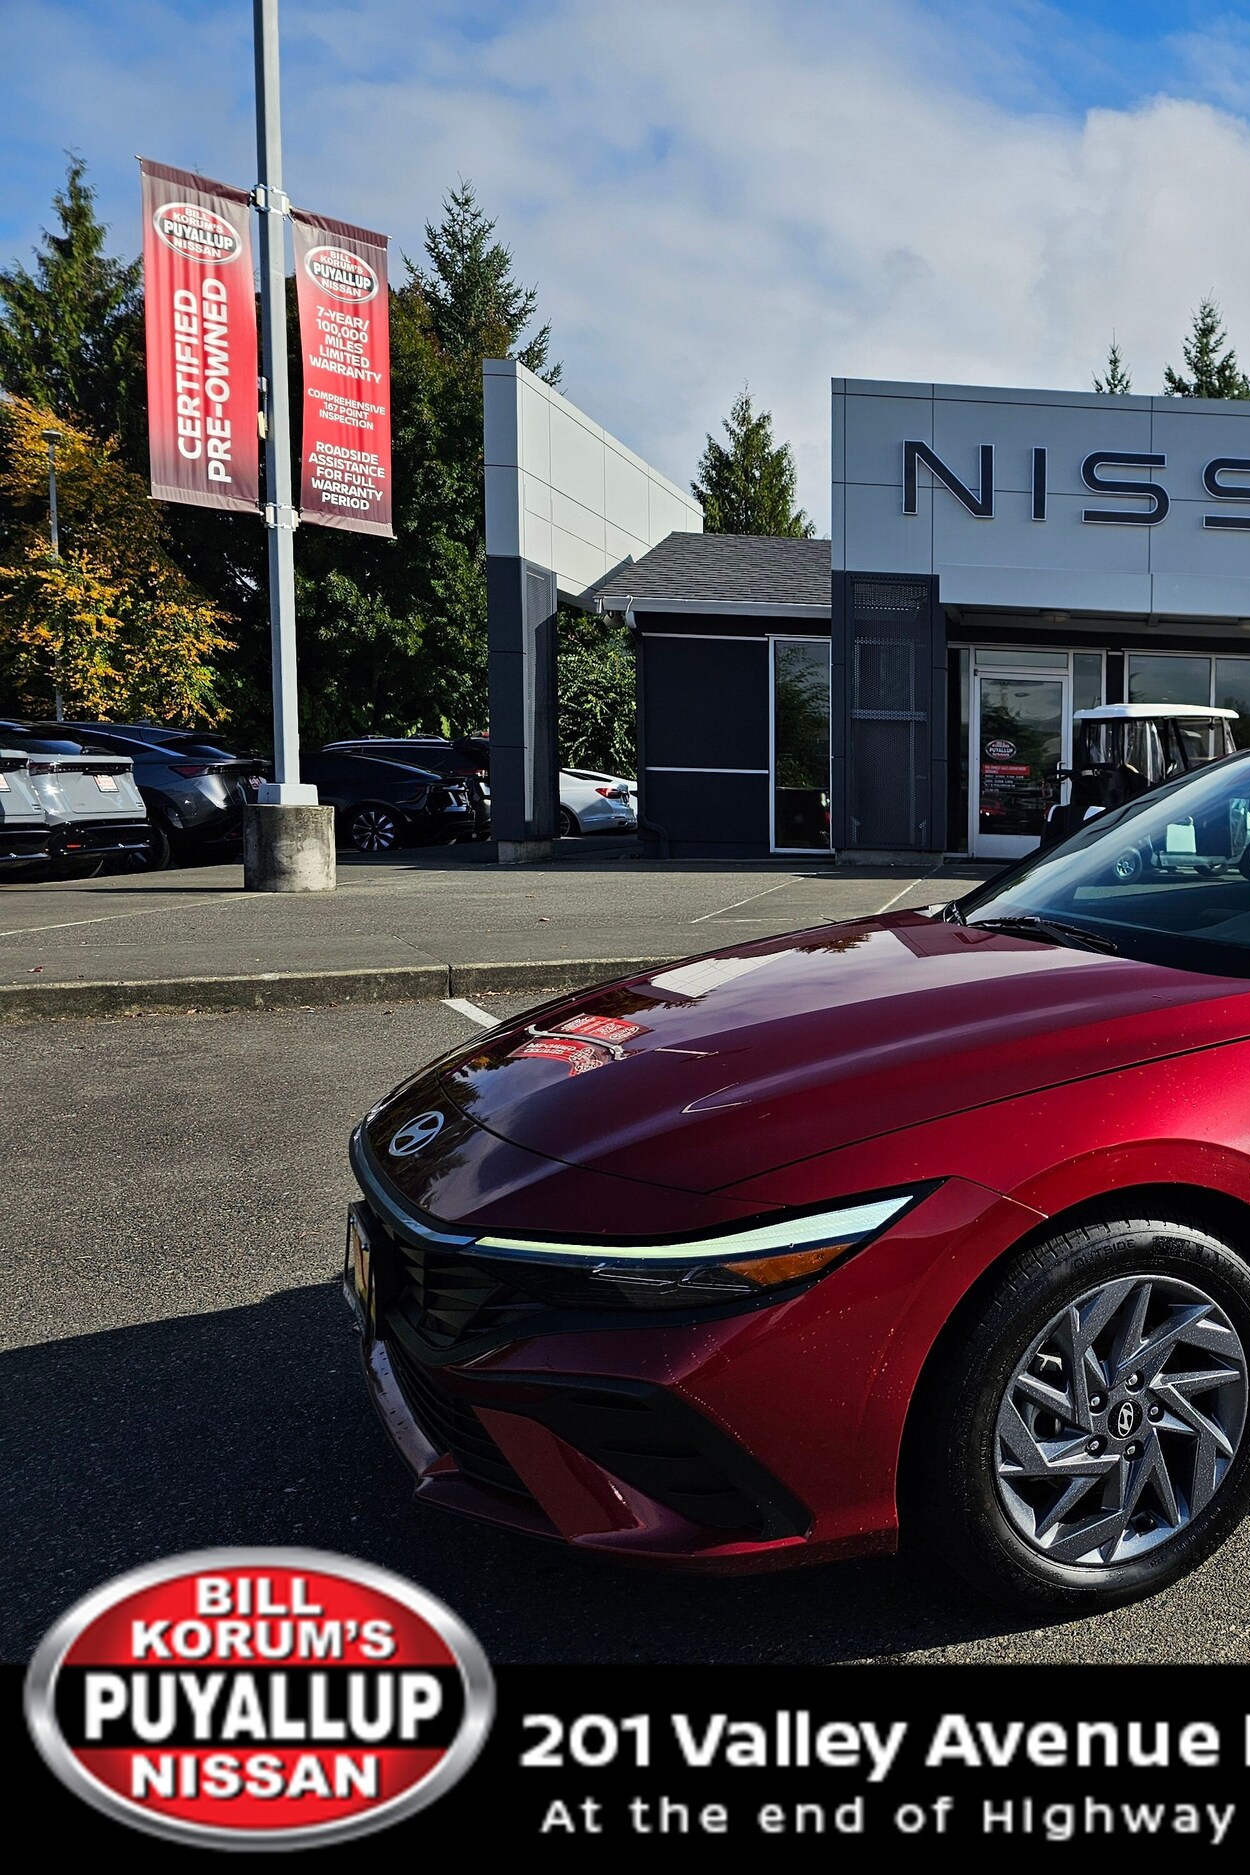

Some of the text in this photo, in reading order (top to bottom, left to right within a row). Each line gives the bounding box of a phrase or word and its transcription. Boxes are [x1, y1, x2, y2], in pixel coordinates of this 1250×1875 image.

[173, 212, 224, 233] KORUM'S
[184, 207, 208, 220] BILL
[163, 219, 234, 250] PUYALLUP
[173, 238, 222, 259] NISSAN
[330, 250, 351, 263] BILL
[313, 262, 372, 290] PUYALLUP
[320, 255, 364, 275] KORUM'S
[321, 278, 362, 298] NISSAN
[316, 306, 370, 331] 7-YEAR/
[316, 318, 369, 343] 100,000
[325, 334, 364, 354] MILES
[319, 345, 370, 369] LIMITED
[174, 289, 201, 460] CERTIFIED
[202, 277, 232, 484] PRE-OWNED
[309, 354, 382, 384] WARRANTY
[307, 388, 386, 415] COMPREHENSIVE
[324, 401, 369, 420] 167 POINT
[319, 409, 374, 430] INSPECTION
[316, 441, 379, 465] ROADSIDE
[308, 452, 385, 478] ASSISTANCE
[316, 467, 376, 488] FOR FULL
[311, 478, 383, 501] WARRANTY
[321, 492, 370, 511] PERIOD
[1073, 1238, 1135, 1269] OUTSIDE
